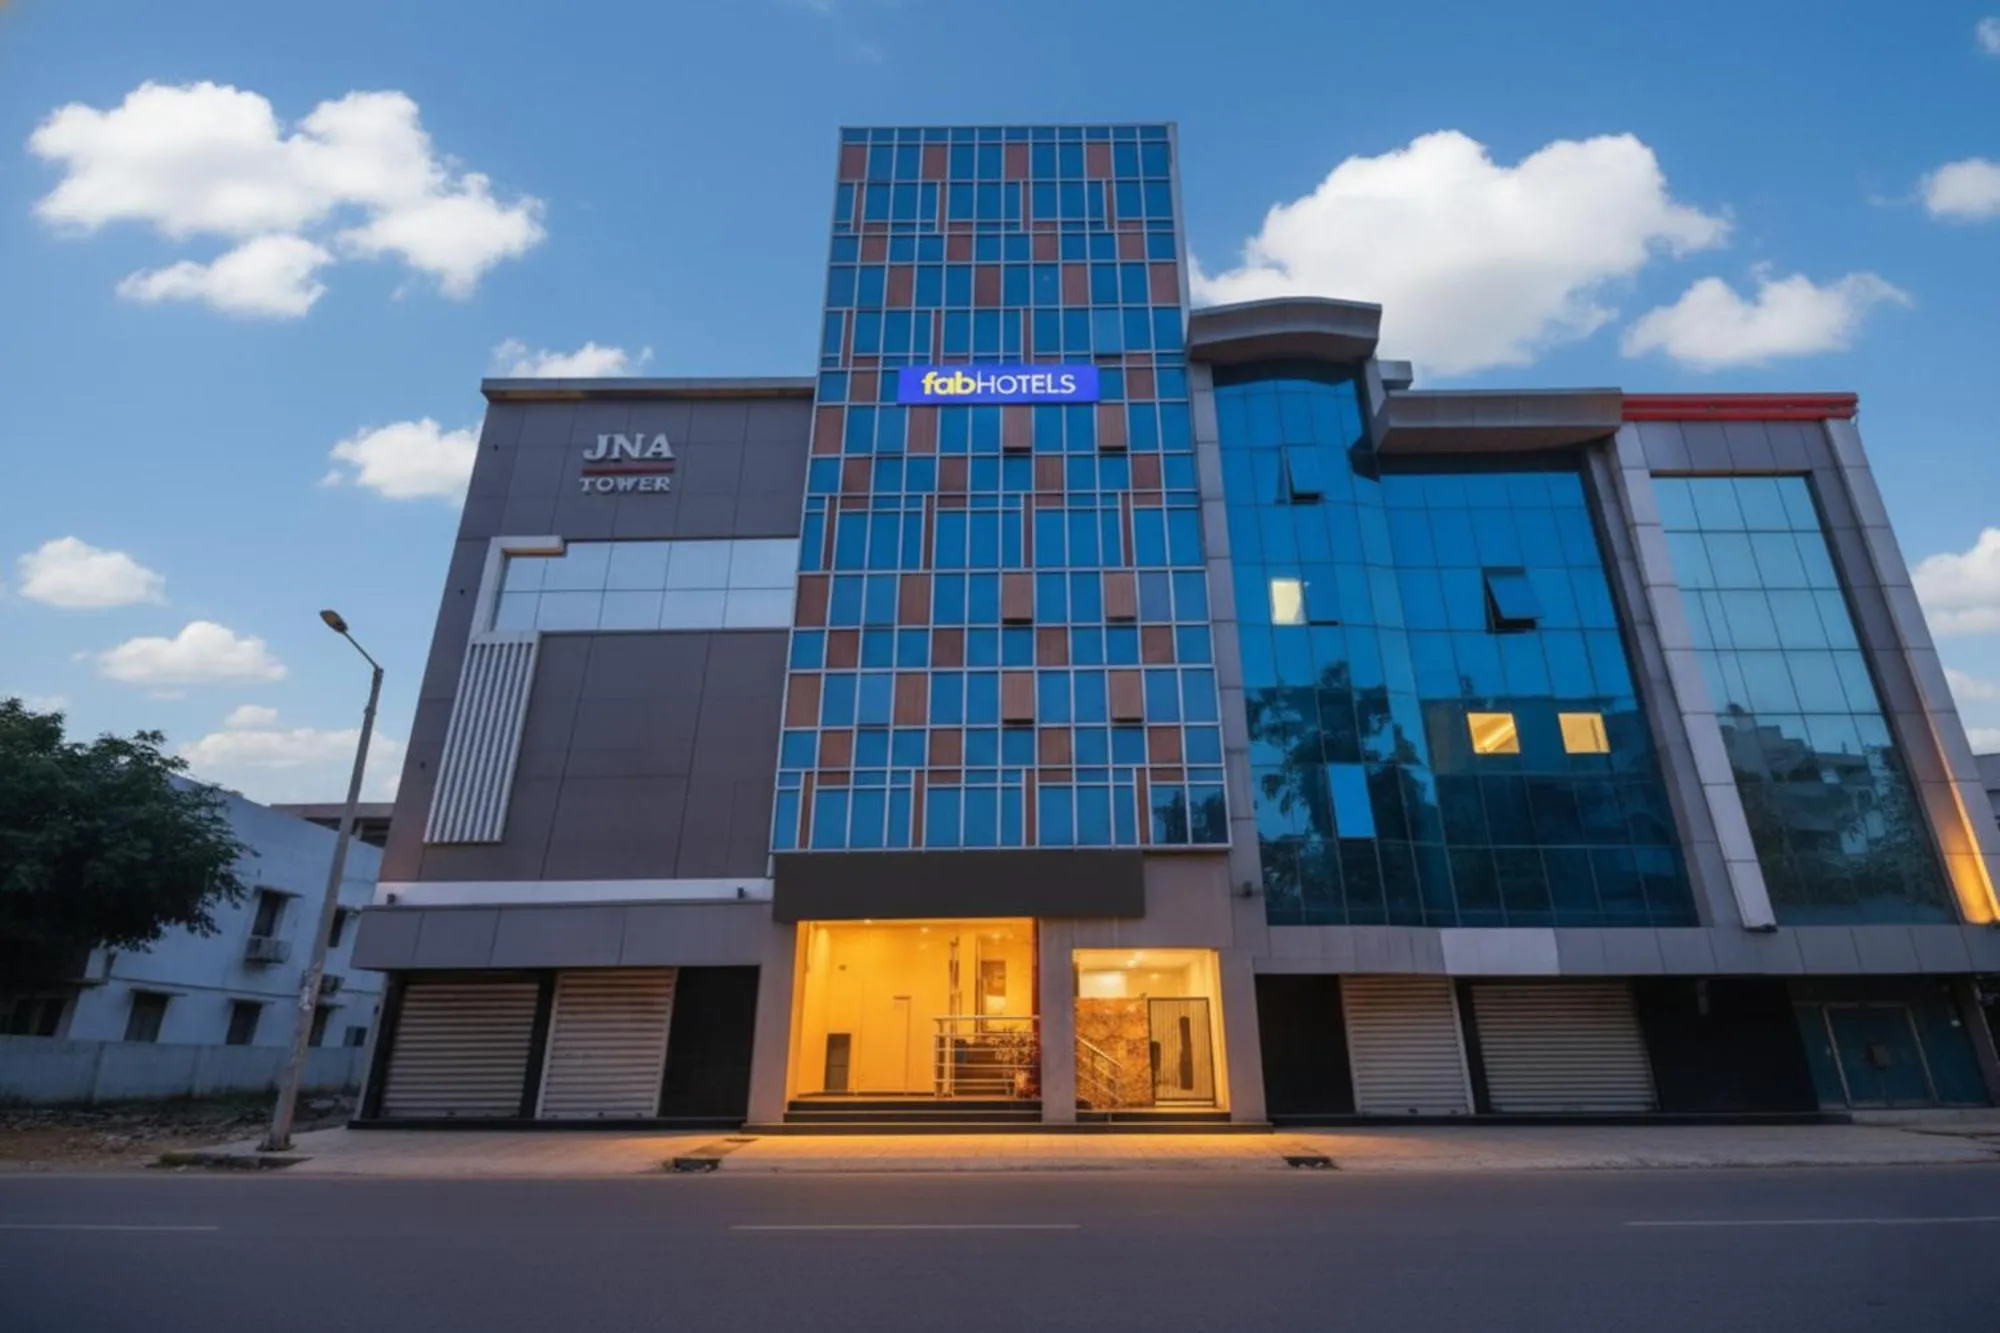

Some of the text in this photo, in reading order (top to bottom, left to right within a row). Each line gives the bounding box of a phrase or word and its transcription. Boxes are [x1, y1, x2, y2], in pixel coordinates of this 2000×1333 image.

[921, 371, 1076, 395] fabHOTELS
[582, 433, 676, 459] JNA
[580, 476, 671, 492] TOWER
